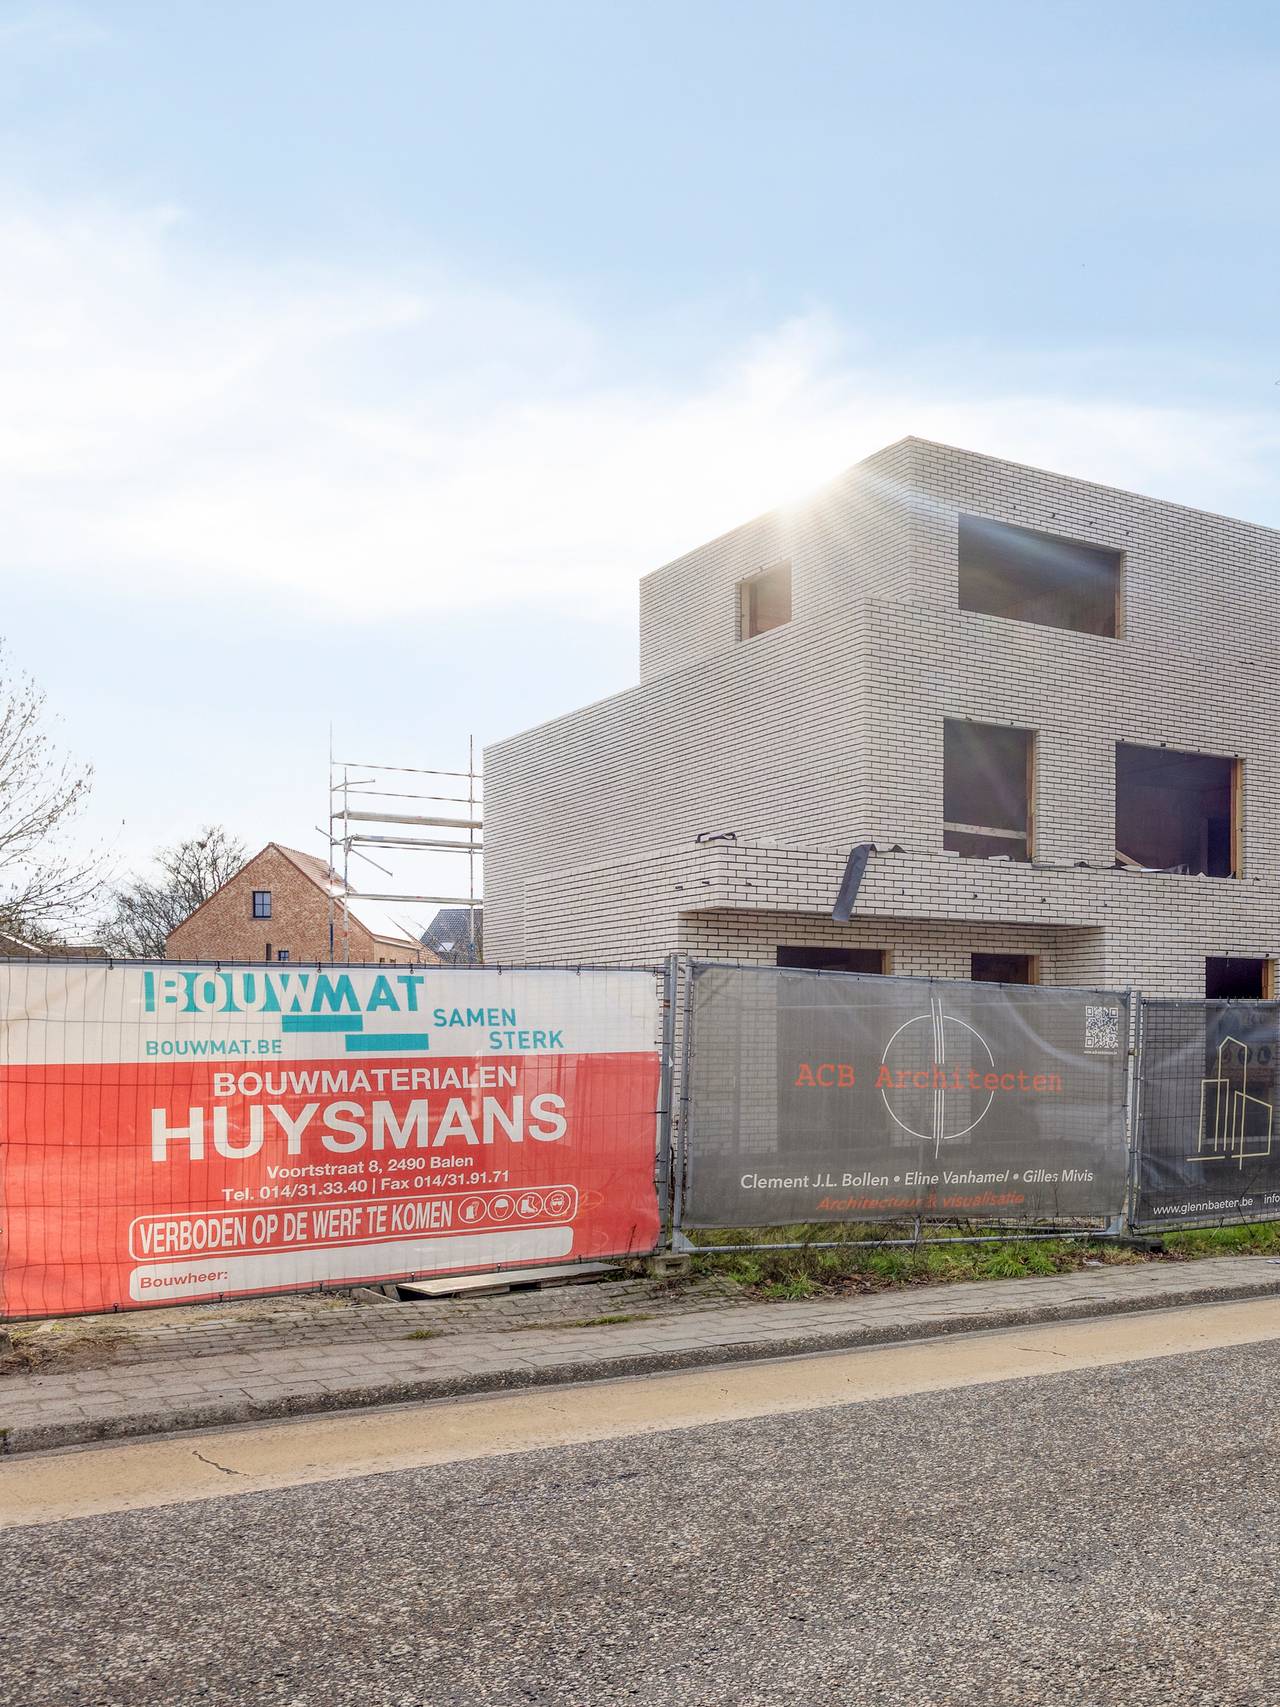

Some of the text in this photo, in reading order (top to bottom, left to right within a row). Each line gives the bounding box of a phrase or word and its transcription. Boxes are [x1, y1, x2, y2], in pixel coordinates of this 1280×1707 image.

[144, 971, 424, 1012] BOUWMAT
[433, 1008, 516, 1027] SAMEN
[146, 1039, 282, 1055] BOUWMAT.BE
[489, 1030, 564, 1049] STERK
[213, 1066, 517, 1097] BOUWMATERIALEN
[794, 1063, 1062, 1092] ACB Architecten
[151, 1093, 568, 1162] HUYSMANS
[266, 1155, 474, 1179] Voortstraat 8, 2490 Balen
[740, 1169, 1094, 1189] Clement J.L. Bollen Eline Vanhamel Gilles Mivis
[222, 1170, 510, 1201] Tel. 014/31.33.40 Fax 014/31.91.71
[1153, 1197, 1253, 1215] www.glennbaeten.be
[140, 1200, 453, 1254] VERBODEN OP DE WERF TE KOMEN
[140, 1270, 228, 1288] Bouwheer:
